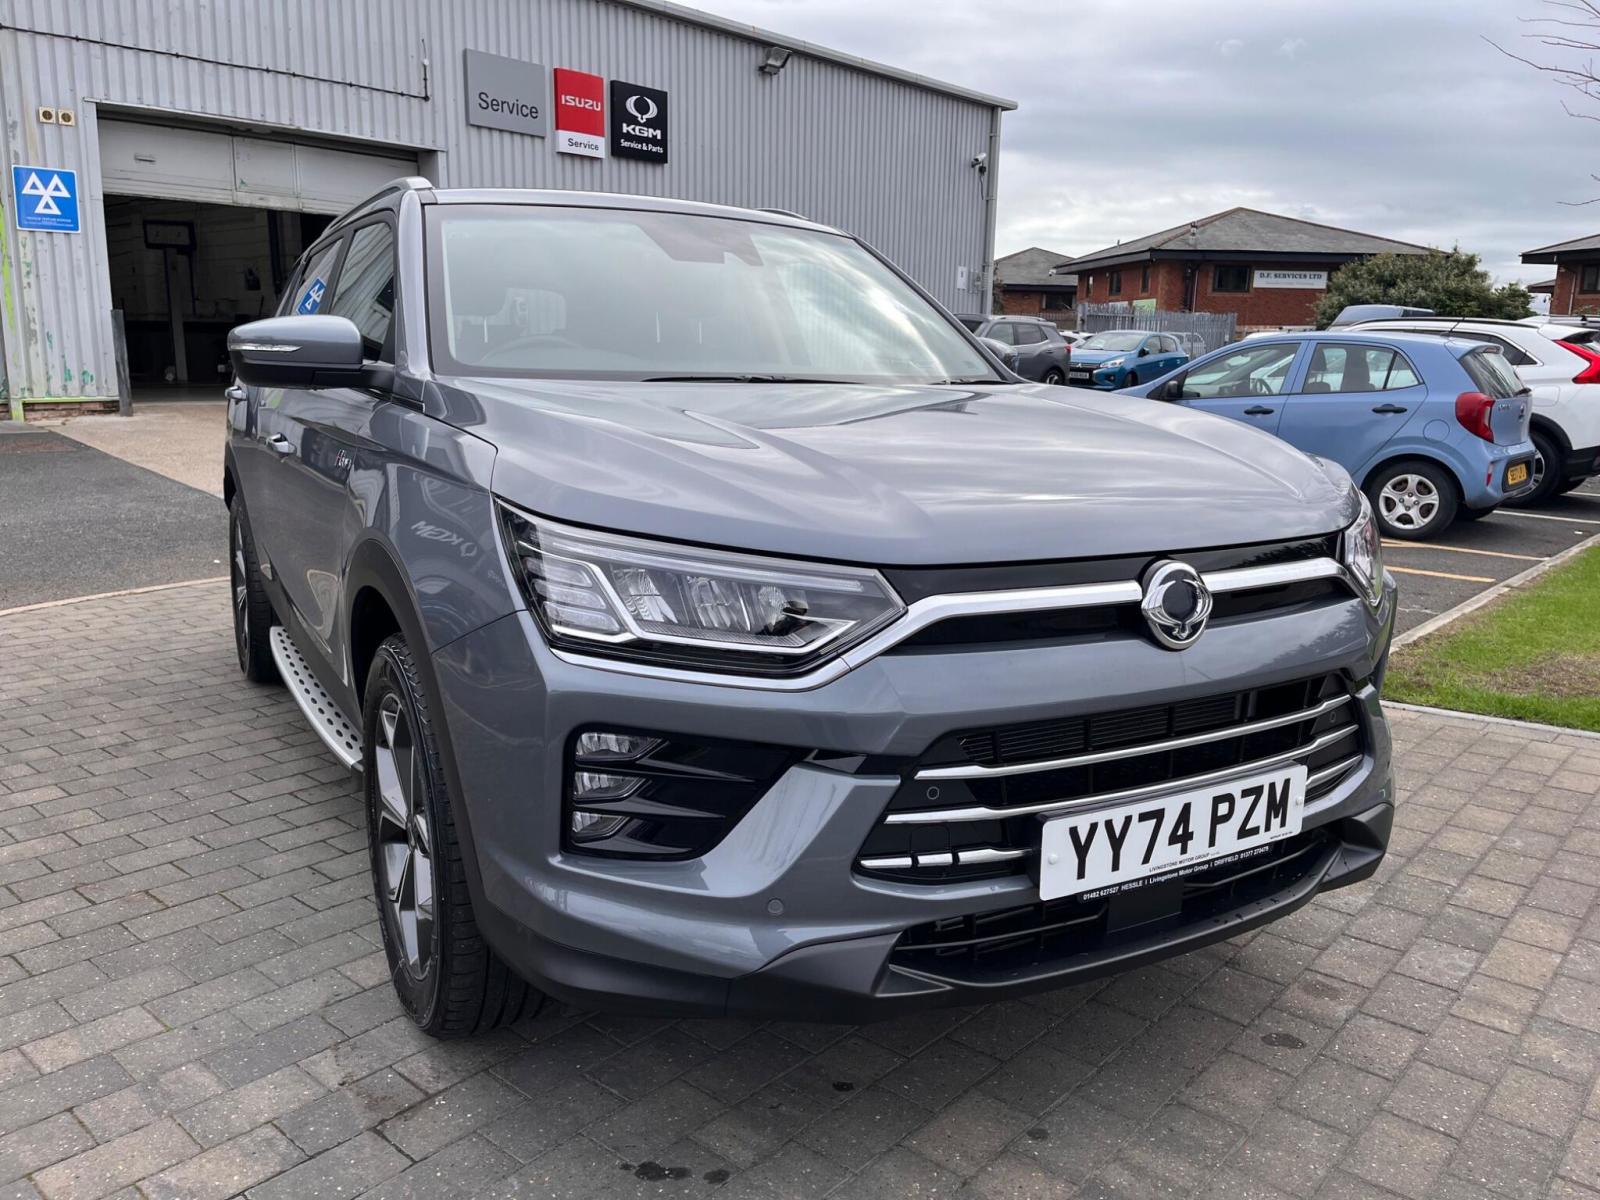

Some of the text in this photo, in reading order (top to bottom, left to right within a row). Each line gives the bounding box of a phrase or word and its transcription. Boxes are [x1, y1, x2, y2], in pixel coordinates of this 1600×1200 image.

[478, 92, 539, 120] Service
[561, 94, 601, 112] ISUZU
[622, 123, 661, 140] KGM
[567, 137, 599, 151] Service
[620, 138, 642, 150] Service
[648, 144, 664, 154] Parts
[1274, 272, 1307, 280] SERVICES
[1069, 777, 1291, 880] YY74 PZM
